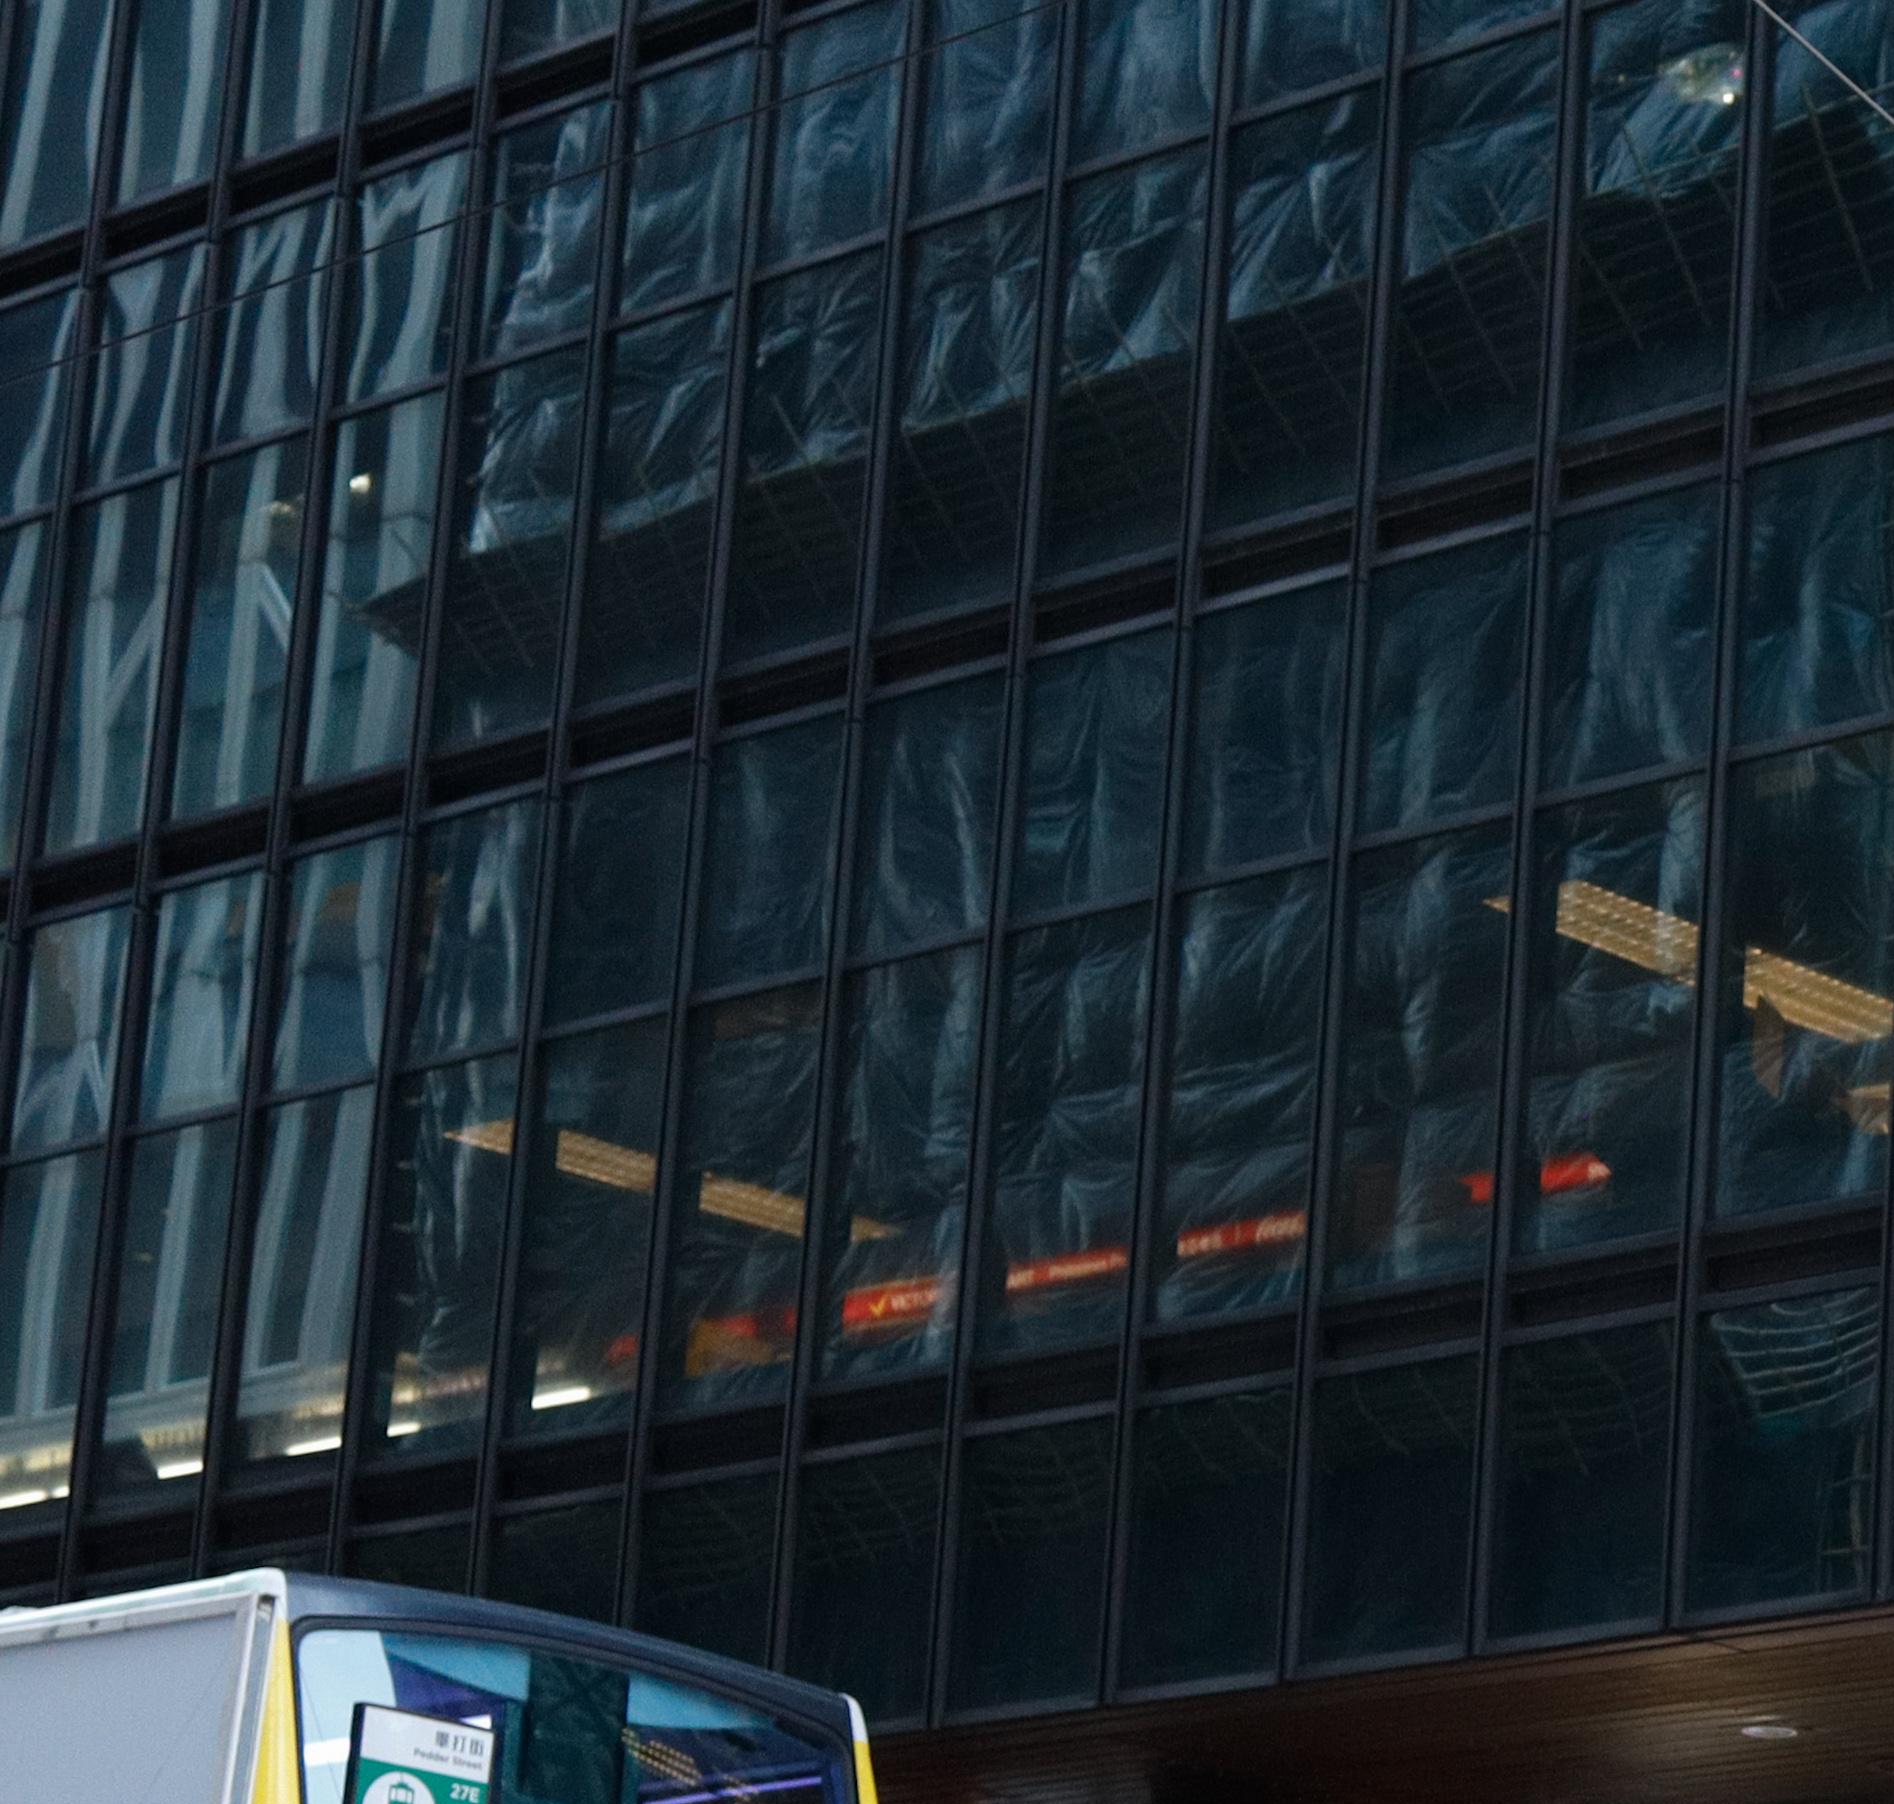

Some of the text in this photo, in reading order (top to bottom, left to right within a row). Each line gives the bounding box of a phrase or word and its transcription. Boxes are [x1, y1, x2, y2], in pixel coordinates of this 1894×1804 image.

[412, 1747, 483, 1770] Pedder Street
[450, 1782, 480, 1803] 27E
